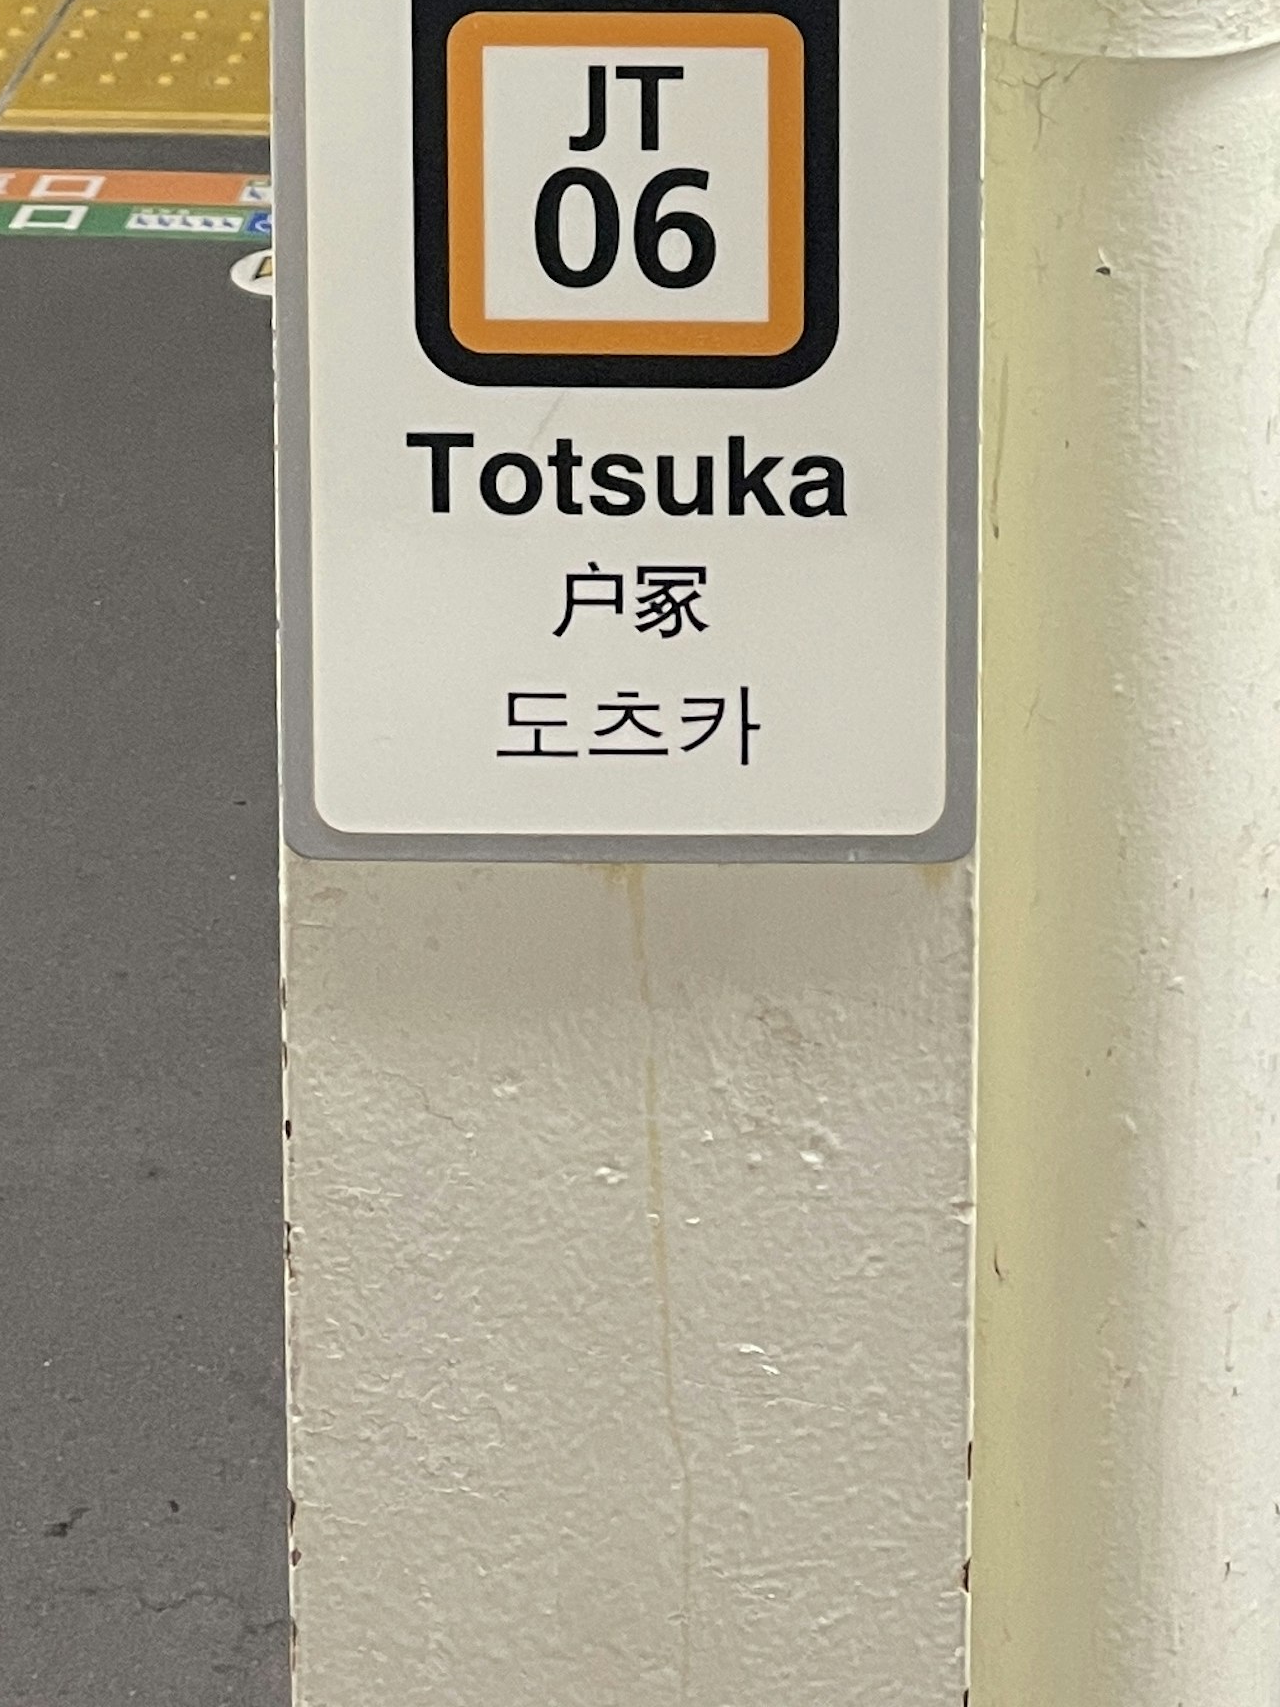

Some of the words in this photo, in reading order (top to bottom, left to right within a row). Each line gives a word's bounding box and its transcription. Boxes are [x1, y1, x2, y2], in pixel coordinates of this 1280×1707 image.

[568, 65, 684, 152] JT
[534, 166, 717, 289] 06
[406, 432, 847, 518] Totsuka
[496, 685, 762, 766] 도츠카
